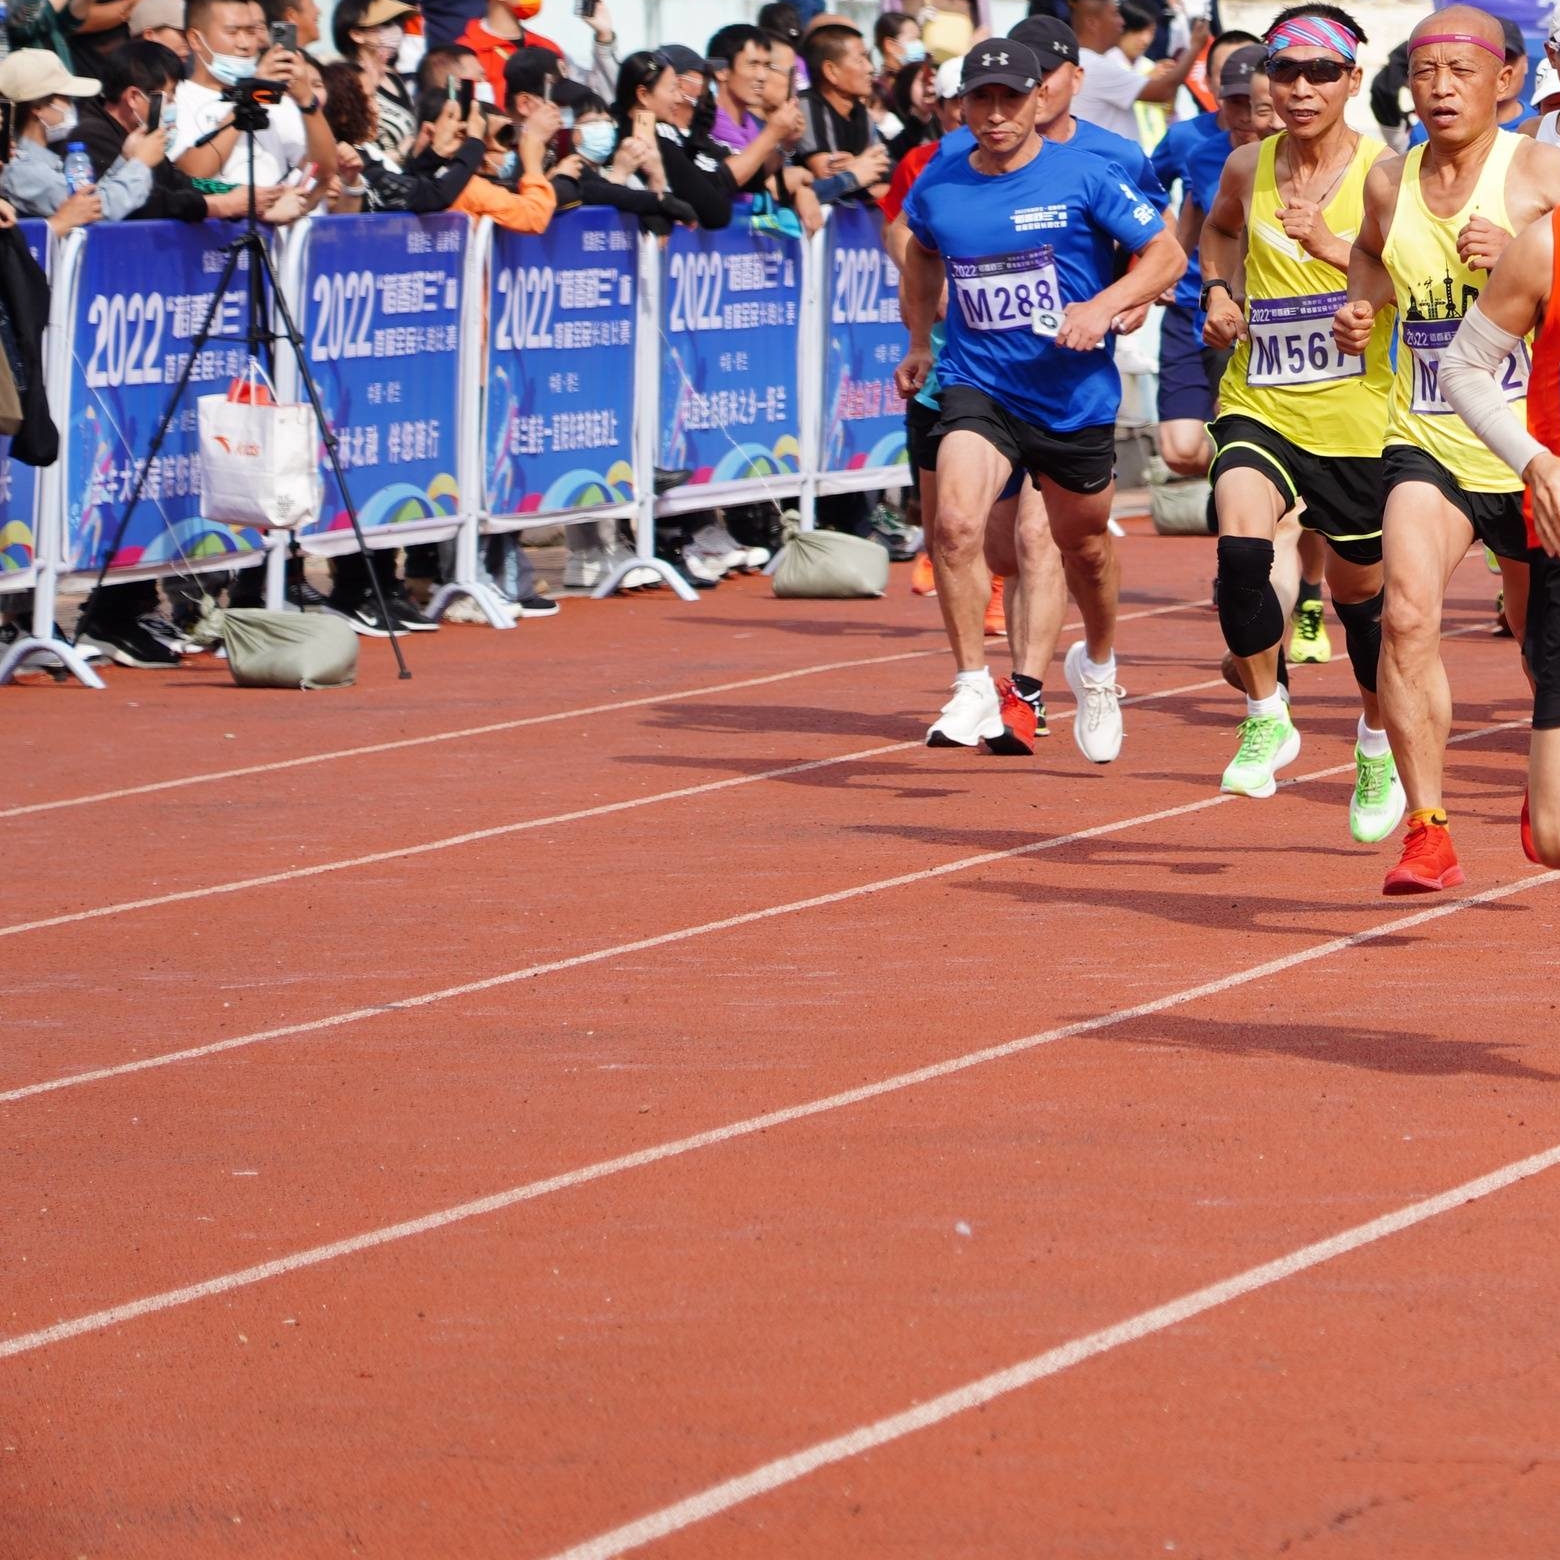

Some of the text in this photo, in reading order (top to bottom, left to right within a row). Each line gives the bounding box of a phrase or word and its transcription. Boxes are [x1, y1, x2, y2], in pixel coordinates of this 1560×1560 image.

[311, 269, 375, 362] 2022
[495, 265, 555, 351] 2022
[670, 251, 723, 333] 2022
[831, 247, 881, 325] 2022
[961, 279, 1055, 324] M288
[1252, 308, 1271, 323] 2022
[86, 292, 166, 389] 2022
[1419, 353, 1523, 403] M2
